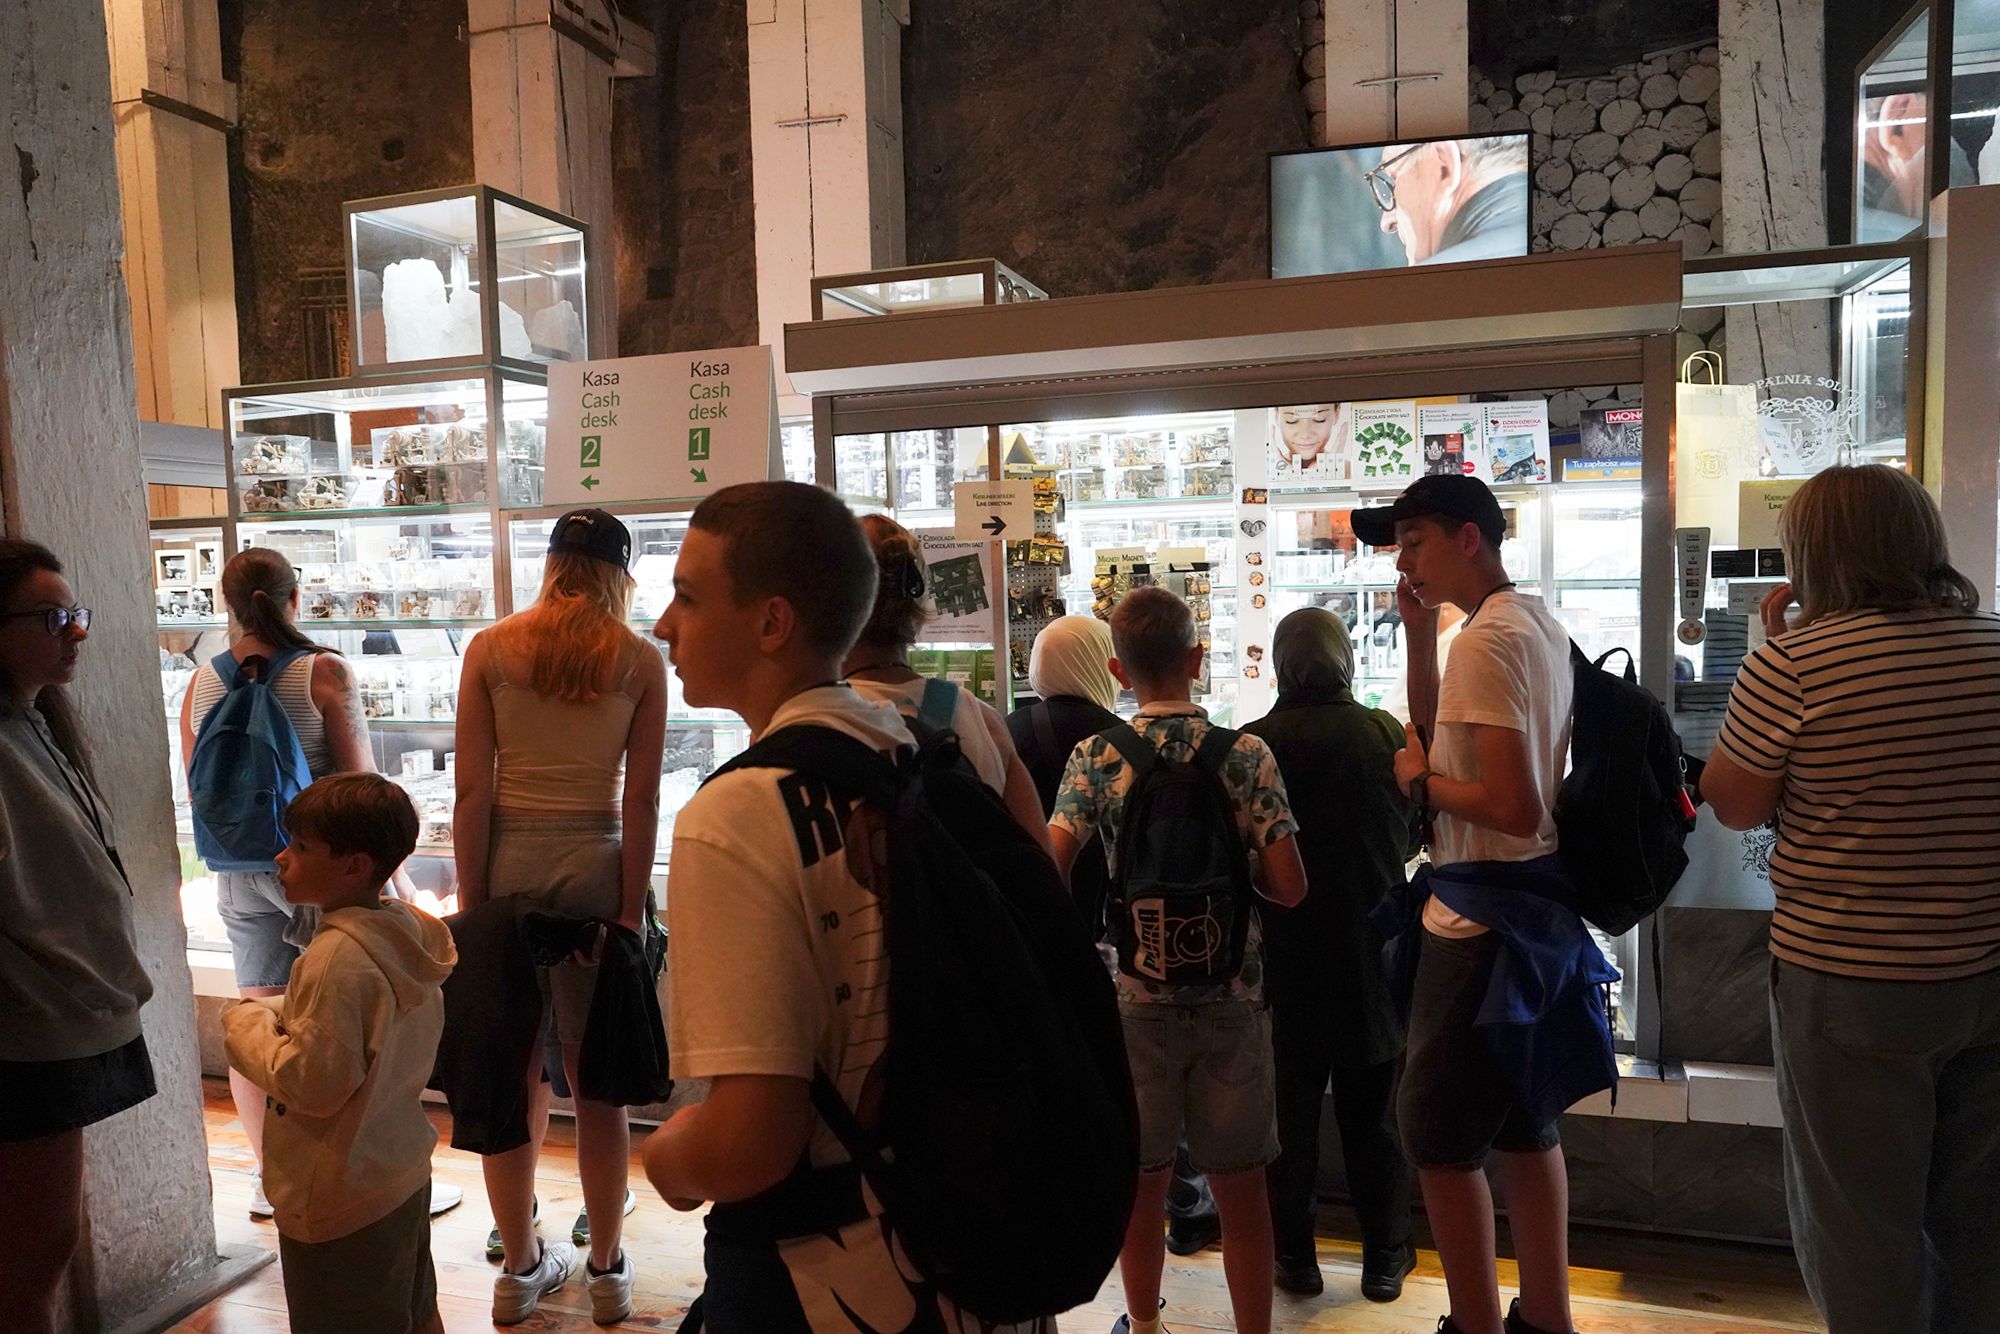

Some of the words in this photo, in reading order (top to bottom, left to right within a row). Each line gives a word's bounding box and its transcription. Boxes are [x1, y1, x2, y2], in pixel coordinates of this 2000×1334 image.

[690, 361, 730, 378] Kasa
[582, 371, 620, 387] Kasa
[689, 382, 730, 400] Cash
[581, 391, 620, 409] Cash
[581, 411, 617, 428] desk
[689, 402, 728, 420] desk
[1609, 412, 1642, 421] MON
[583, 438, 598, 463] 2
[692, 431, 706, 456] 1
[1584, 459, 1618, 469] zapłacisz
[1122, 554, 1145, 562] MAGNETS
[820, 910, 840, 932] 70
